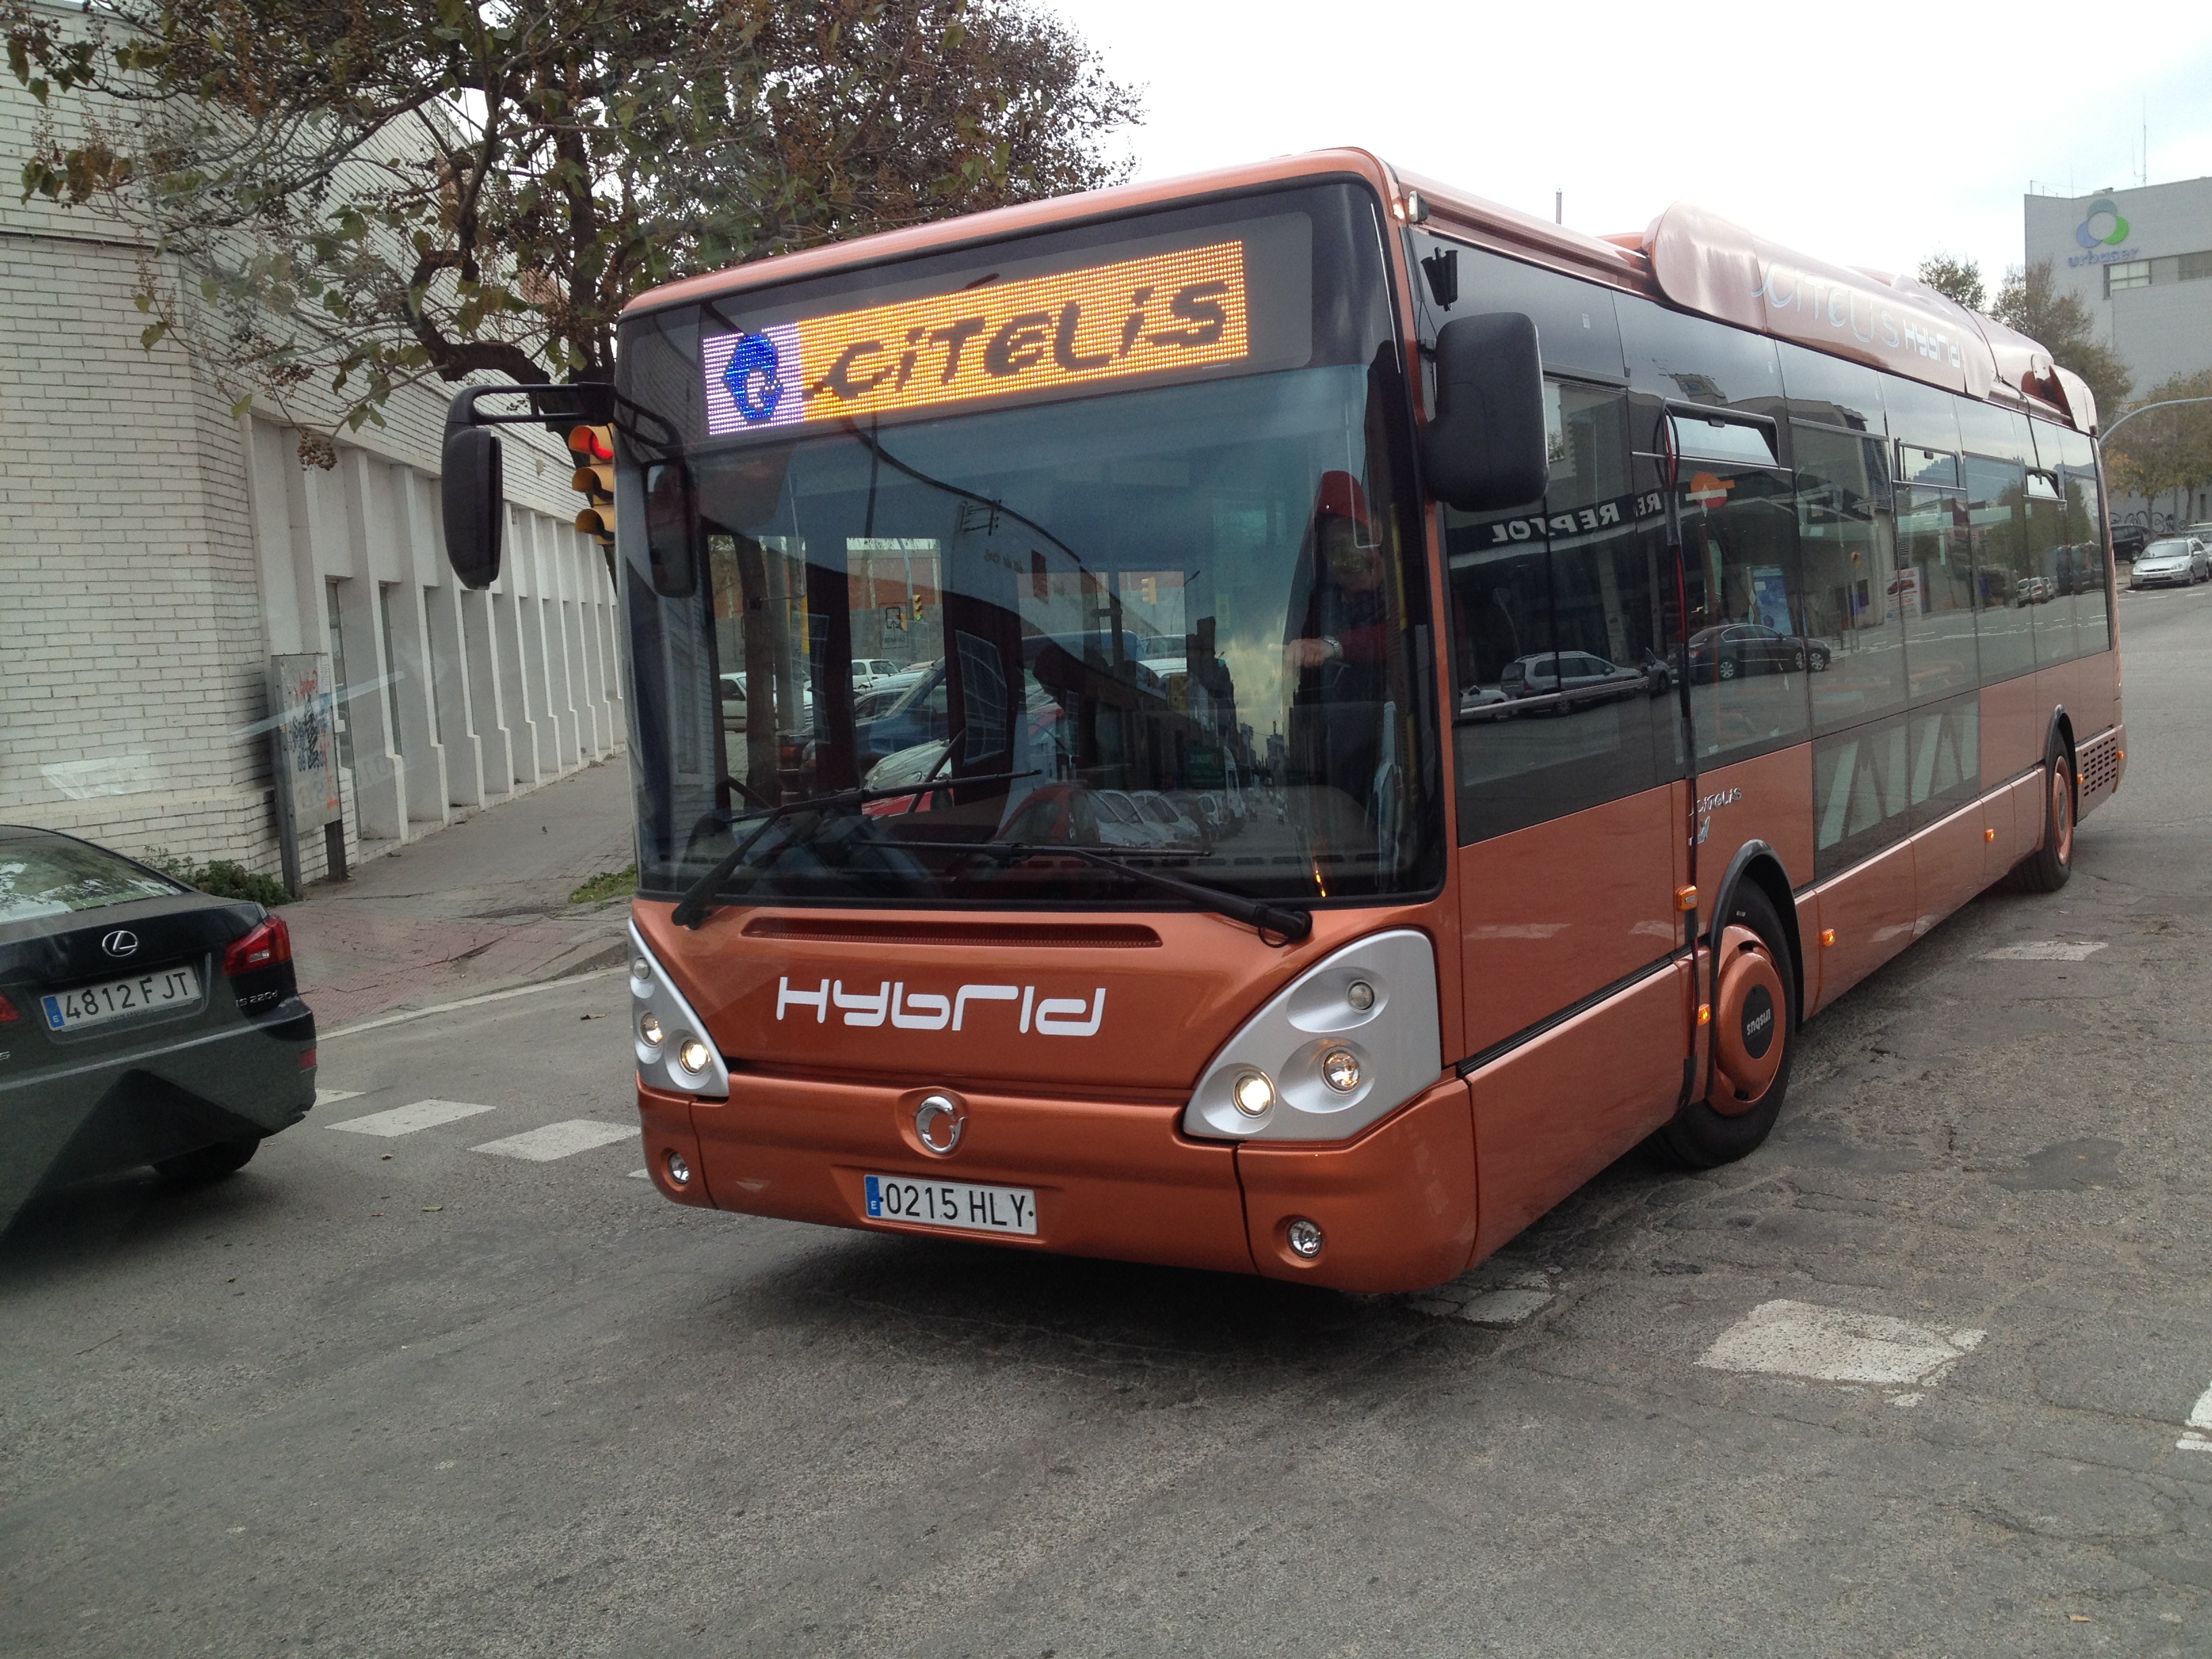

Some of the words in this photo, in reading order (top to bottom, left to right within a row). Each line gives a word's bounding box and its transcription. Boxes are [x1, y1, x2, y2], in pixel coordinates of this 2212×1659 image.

[65, 984, 136, 1019] 4812
[140, 971, 190, 1004] FJT
[869, 1199, 878, 1210] E
[885, 1183, 958, 1221] 0215
[969, 1191, 1026, 1228] HLY
